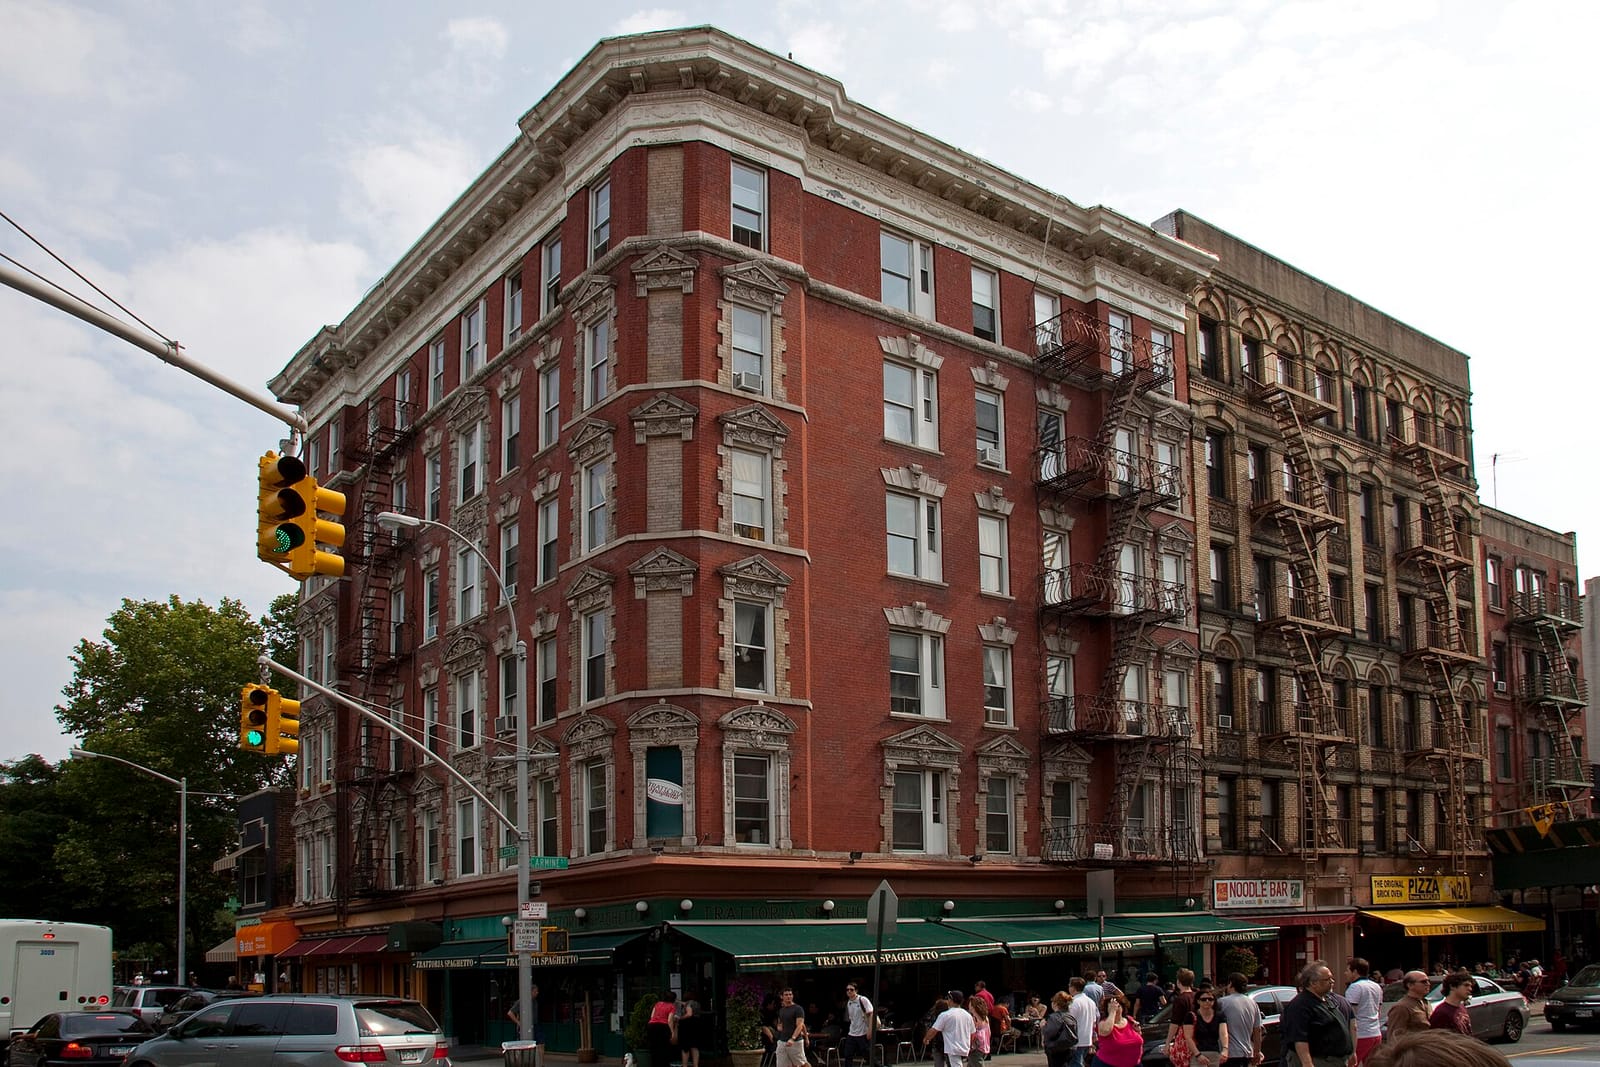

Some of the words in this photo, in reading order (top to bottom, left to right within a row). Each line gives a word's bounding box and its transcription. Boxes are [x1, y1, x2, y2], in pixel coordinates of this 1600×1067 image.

[530, 857, 561, 868] CARMINE
[1229, 881, 1266, 897] NOODLE
[1269, 881, 1287, 897] BAR
[1374, 880, 1383, 888] THE
[1383, 880, 1404, 888] ORIGINAL
[1408, 878, 1440, 893] PIZZA
[1376, 889, 1390, 898] BRICK
[1391, 889, 1403, 898] OVEN
[704, 904, 798, 919] TRATTORIA
[1184, 935, 1220, 944] TRATTORIA
[1220, 931, 1260, 942] SPAGHETTO
[1037, 944, 1083, 955] TRATTORIA
[416, 960, 444, 968] TRATTORIA
[444, 958, 474, 968] SPAGHETTO
[541, 955, 578, 965] SPAGHETTO
[815, 954, 877, 966] TRATTORIA
[880, 950, 939, 963] SPAGHETTO
